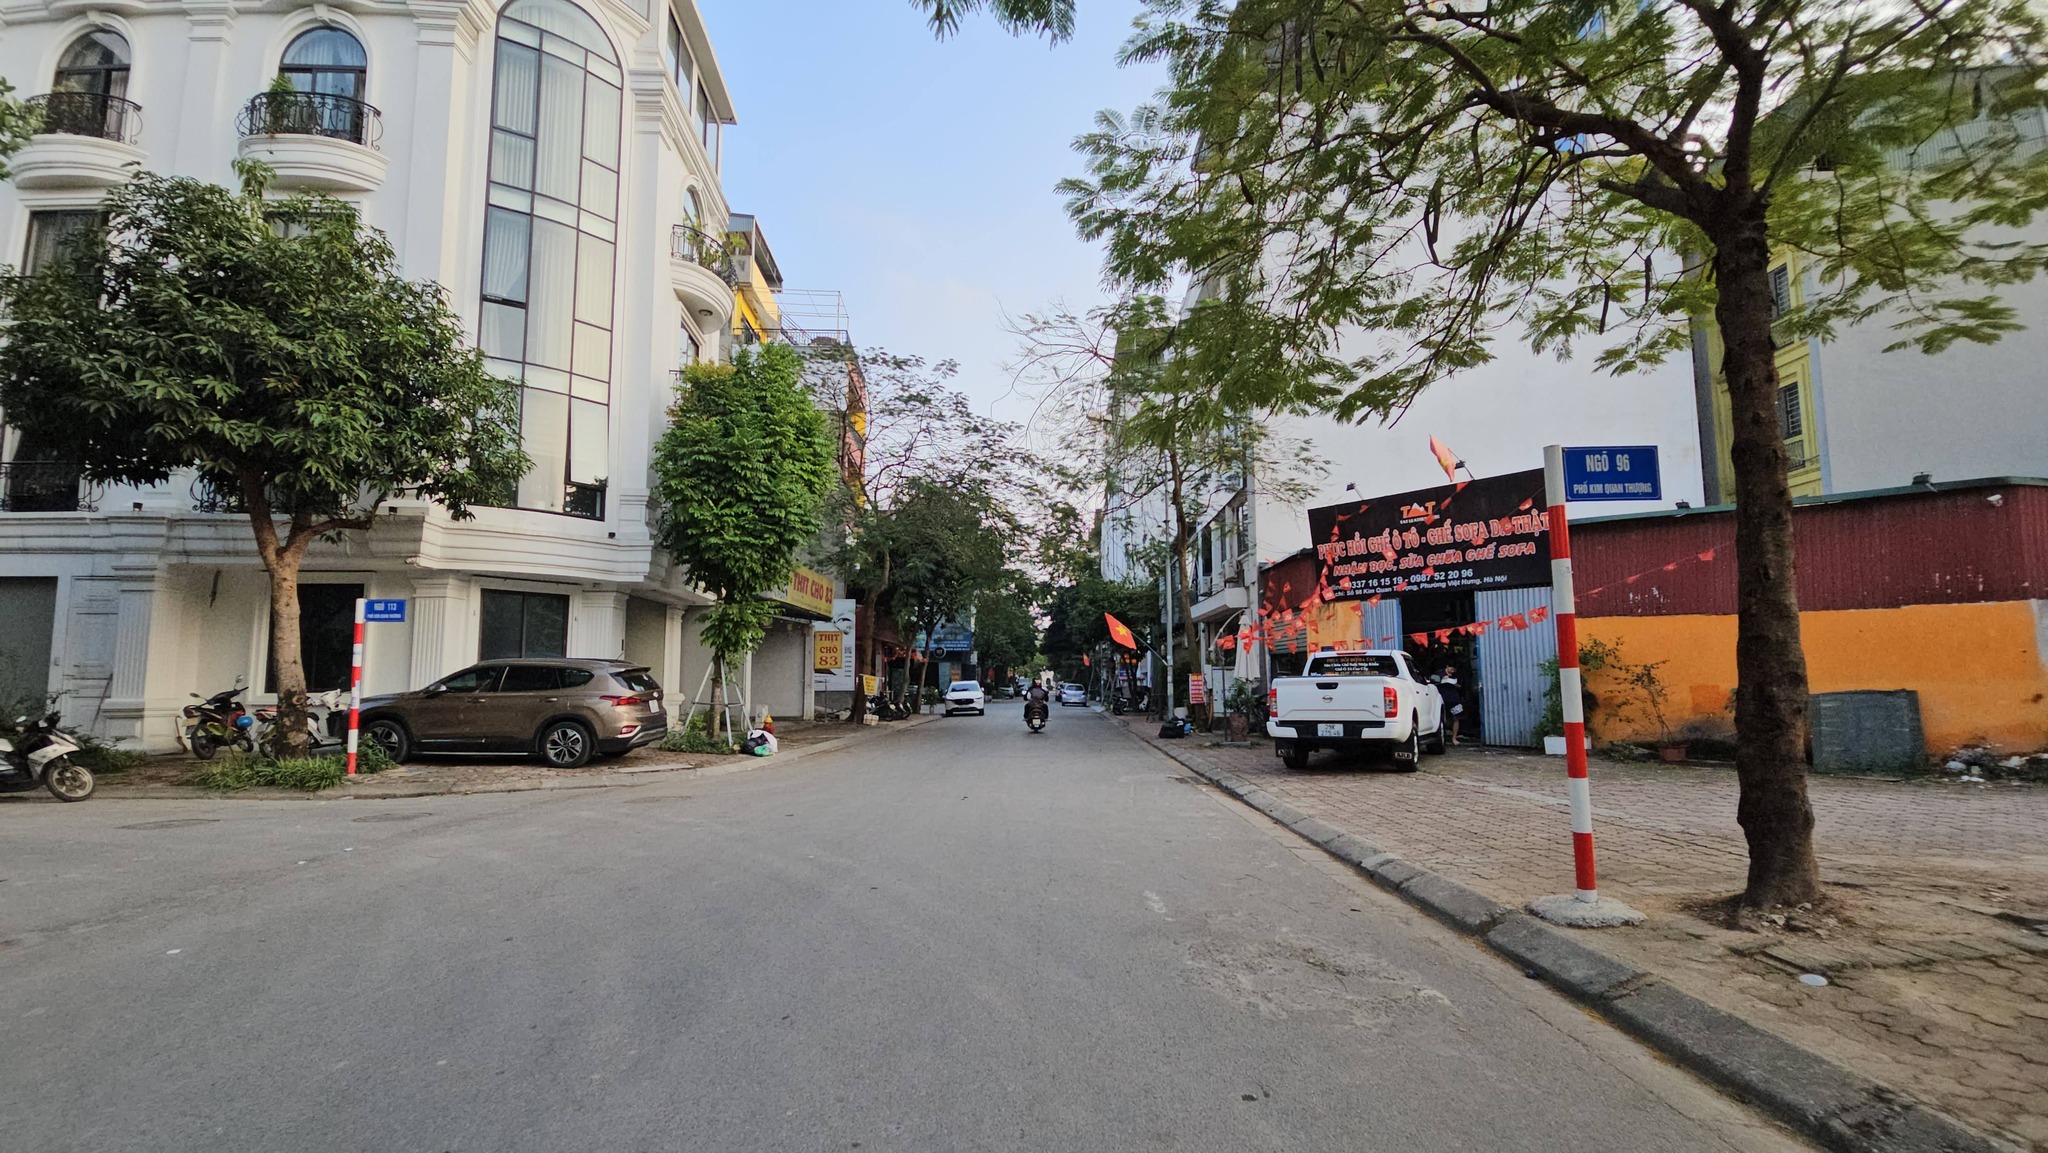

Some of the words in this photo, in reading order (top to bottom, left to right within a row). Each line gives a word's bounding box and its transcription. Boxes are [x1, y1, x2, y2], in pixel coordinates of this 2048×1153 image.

[1585, 451, 1609, 472] NGÕ
[1616, 454, 1630, 472] 96
[1573, 480, 1588, 494] PHỐ
[1589, 483, 1603, 494] KIM
[1604, 483, 1623, 494] QUAN
[1625, 482, 1652, 495] THƯỢNG
[1316, 541, 1346, 562] PHỤC
[1367, 528, 1392, 553] GHẾ
[1392, 528, 1402, 550] Ô
[1402, 526, 1420, 549] TÔ
[1427, 519, 1453, 545] GHẾ
[1454, 520, 1489, 542] SOFA
[1369, 560, 1398, 574] BỌC,
[1399, 552, 1424, 570] SỬA
[1426, 549, 1462, 566] CHỮA
[1465, 542, 1496, 561] GHẾ
[1498, 541, 1536, 558] SOFA
[1368, 579, 1378, 587] 16
[1380, 578, 1391, 586] 15
[1392, 576, 1403, 585] 19
[1410, 573, 1431, 583] 0987
[1434, 571, 1446, 580] 52
[1447, 570, 1459, 579] 20
[1461, 568, 1474, 578] 96
[818, 633, 840, 643] THỊT
[819, 644, 838, 654] CHÓ
[819, 656, 838, 667] 83
